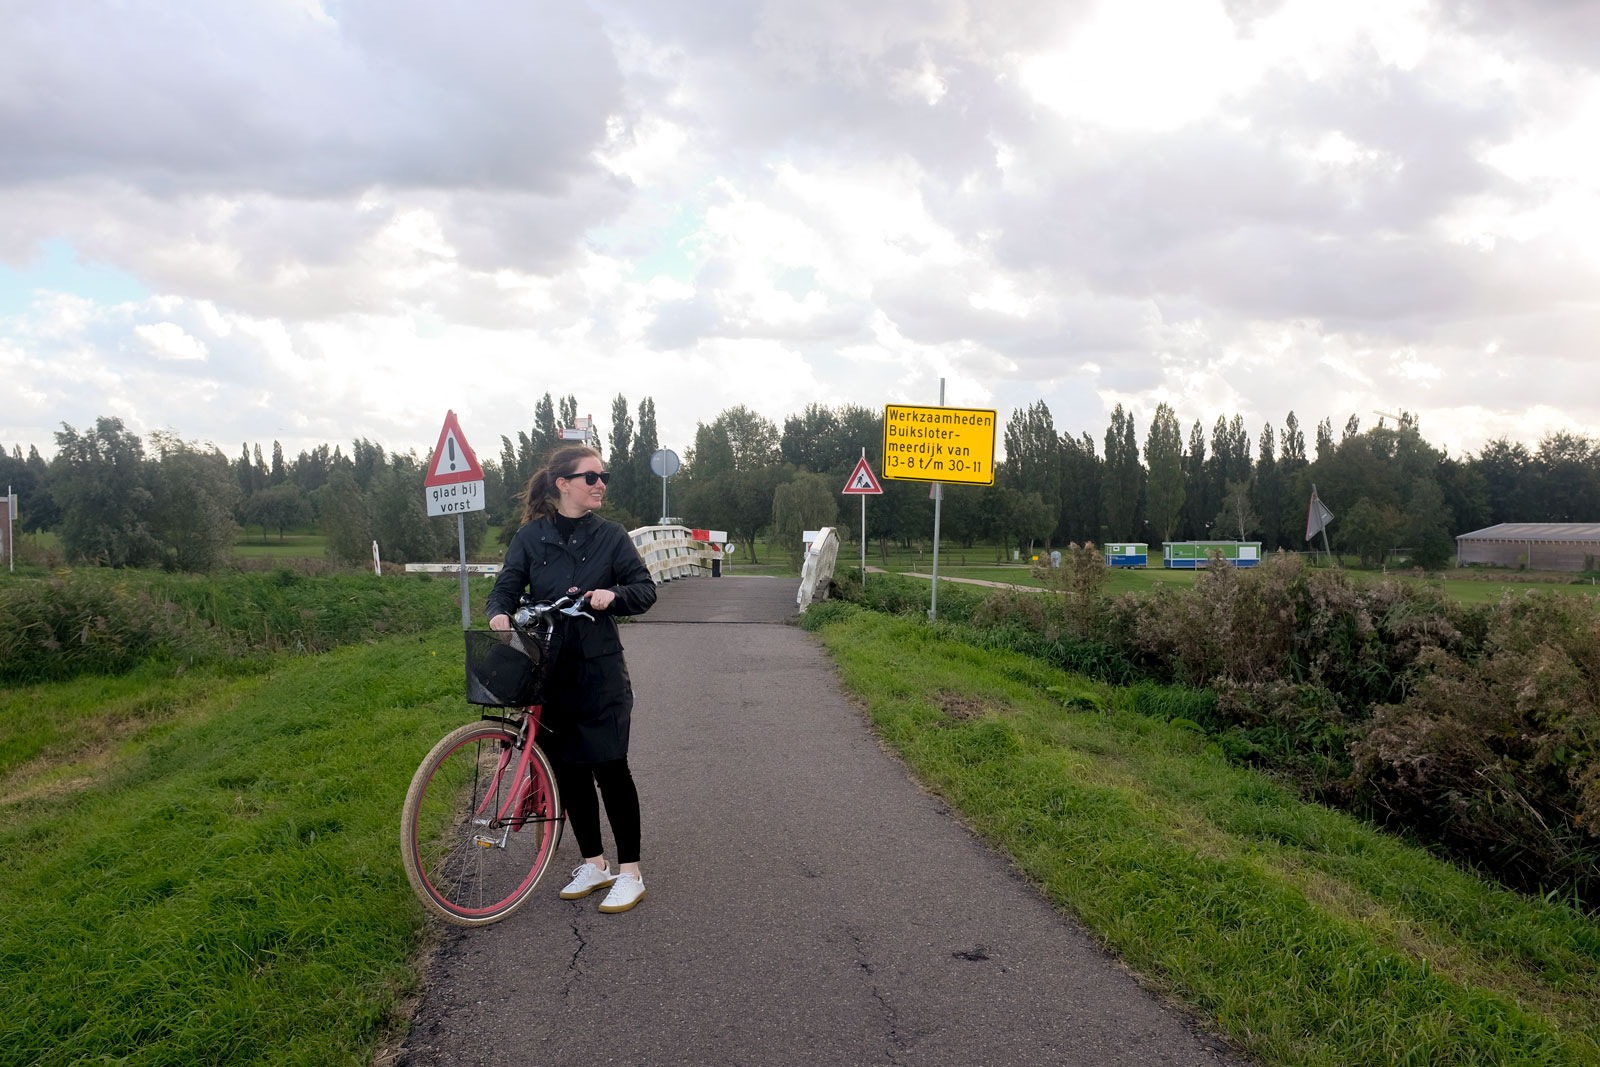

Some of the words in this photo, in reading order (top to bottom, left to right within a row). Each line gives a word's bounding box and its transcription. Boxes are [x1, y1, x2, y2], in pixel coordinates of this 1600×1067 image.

[890, 409, 991, 426] Werkzaamheden
[890, 425, 960, 439] Buiksloter-
[889, 442, 942, 457] meerdijk
[948, 446, 969, 456] van
[887, 456, 914, 468] 13-8
[919, 457, 943, 470] t/m
[948, 460, 981, 472] 30-11
[433, 486, 456, 502] glad
[462, 483, 477, 496] bij
[441, 499, 471, 512] vorst
